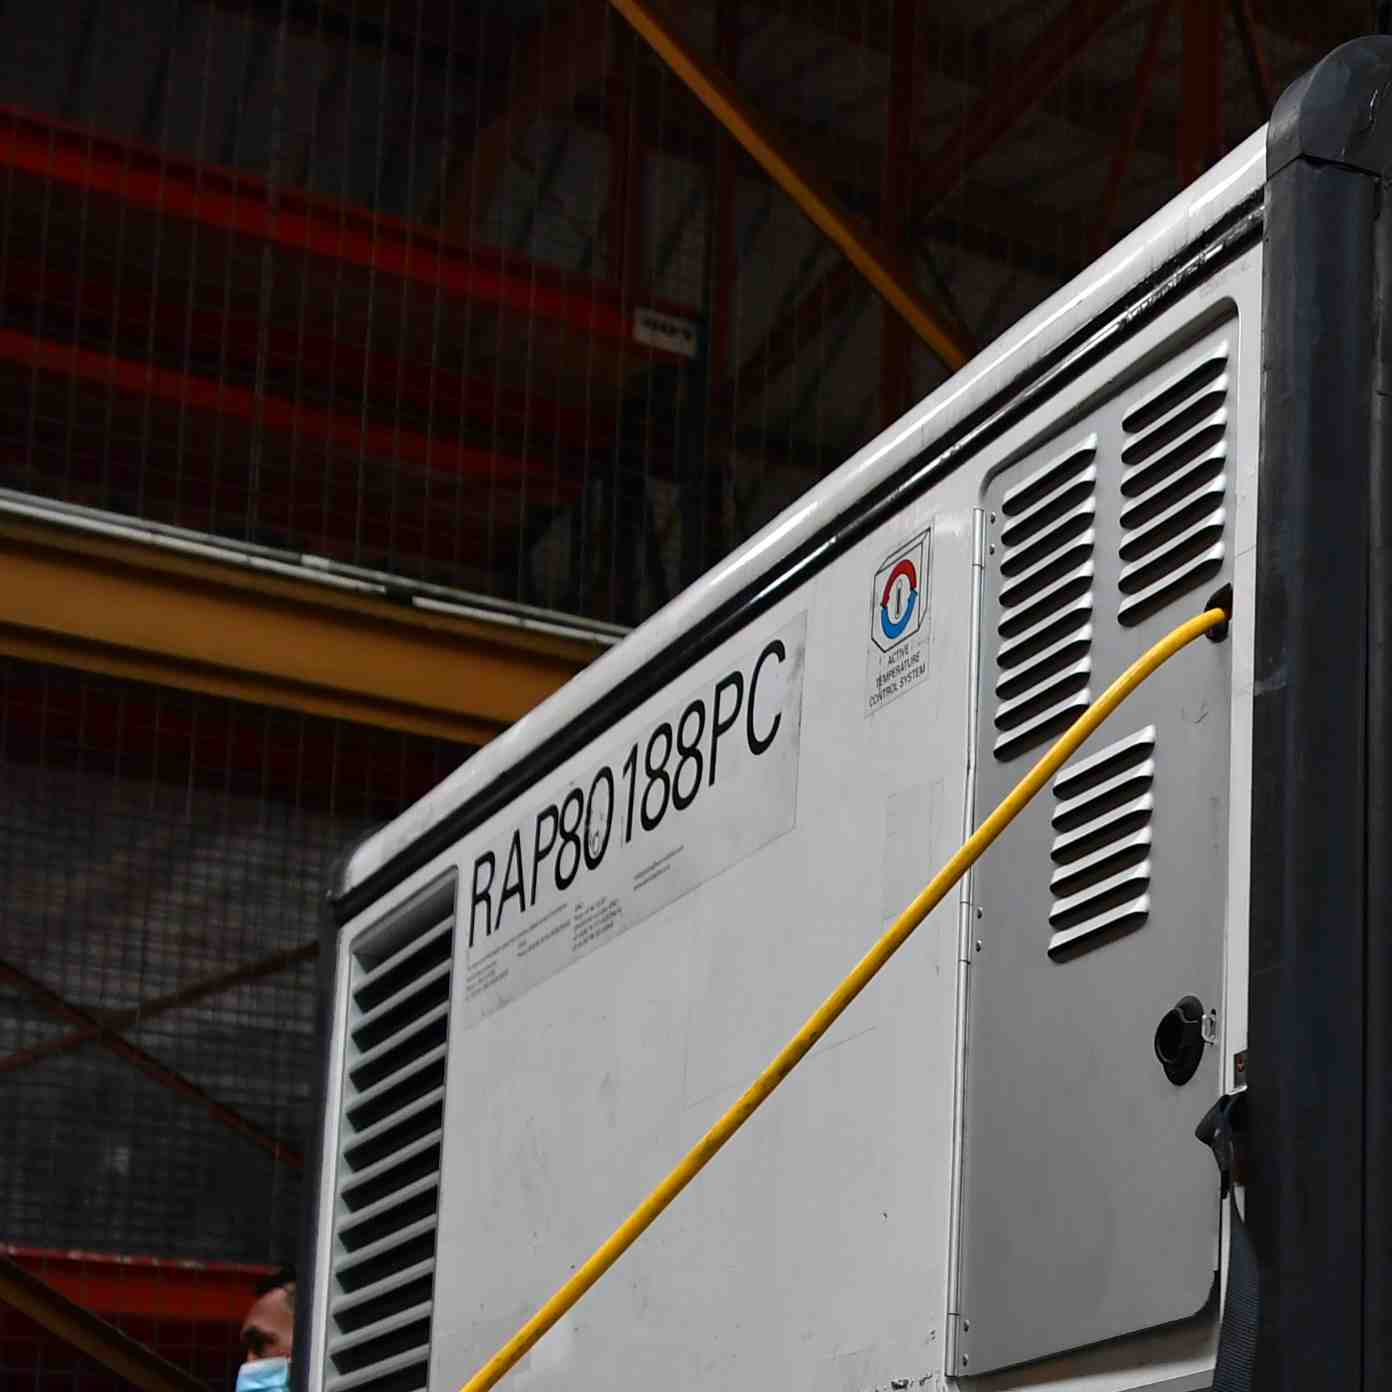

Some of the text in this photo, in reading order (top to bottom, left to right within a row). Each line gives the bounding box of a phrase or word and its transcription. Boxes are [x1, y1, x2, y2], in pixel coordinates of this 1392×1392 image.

[876, 650, 921, 689] TEMPERATURE
[888, 643, 911, 665] ACTIVE
[868, 663, 927, 708] CONTROL SYSTEM
[467, 638, 787, 949] RAP80188PC
